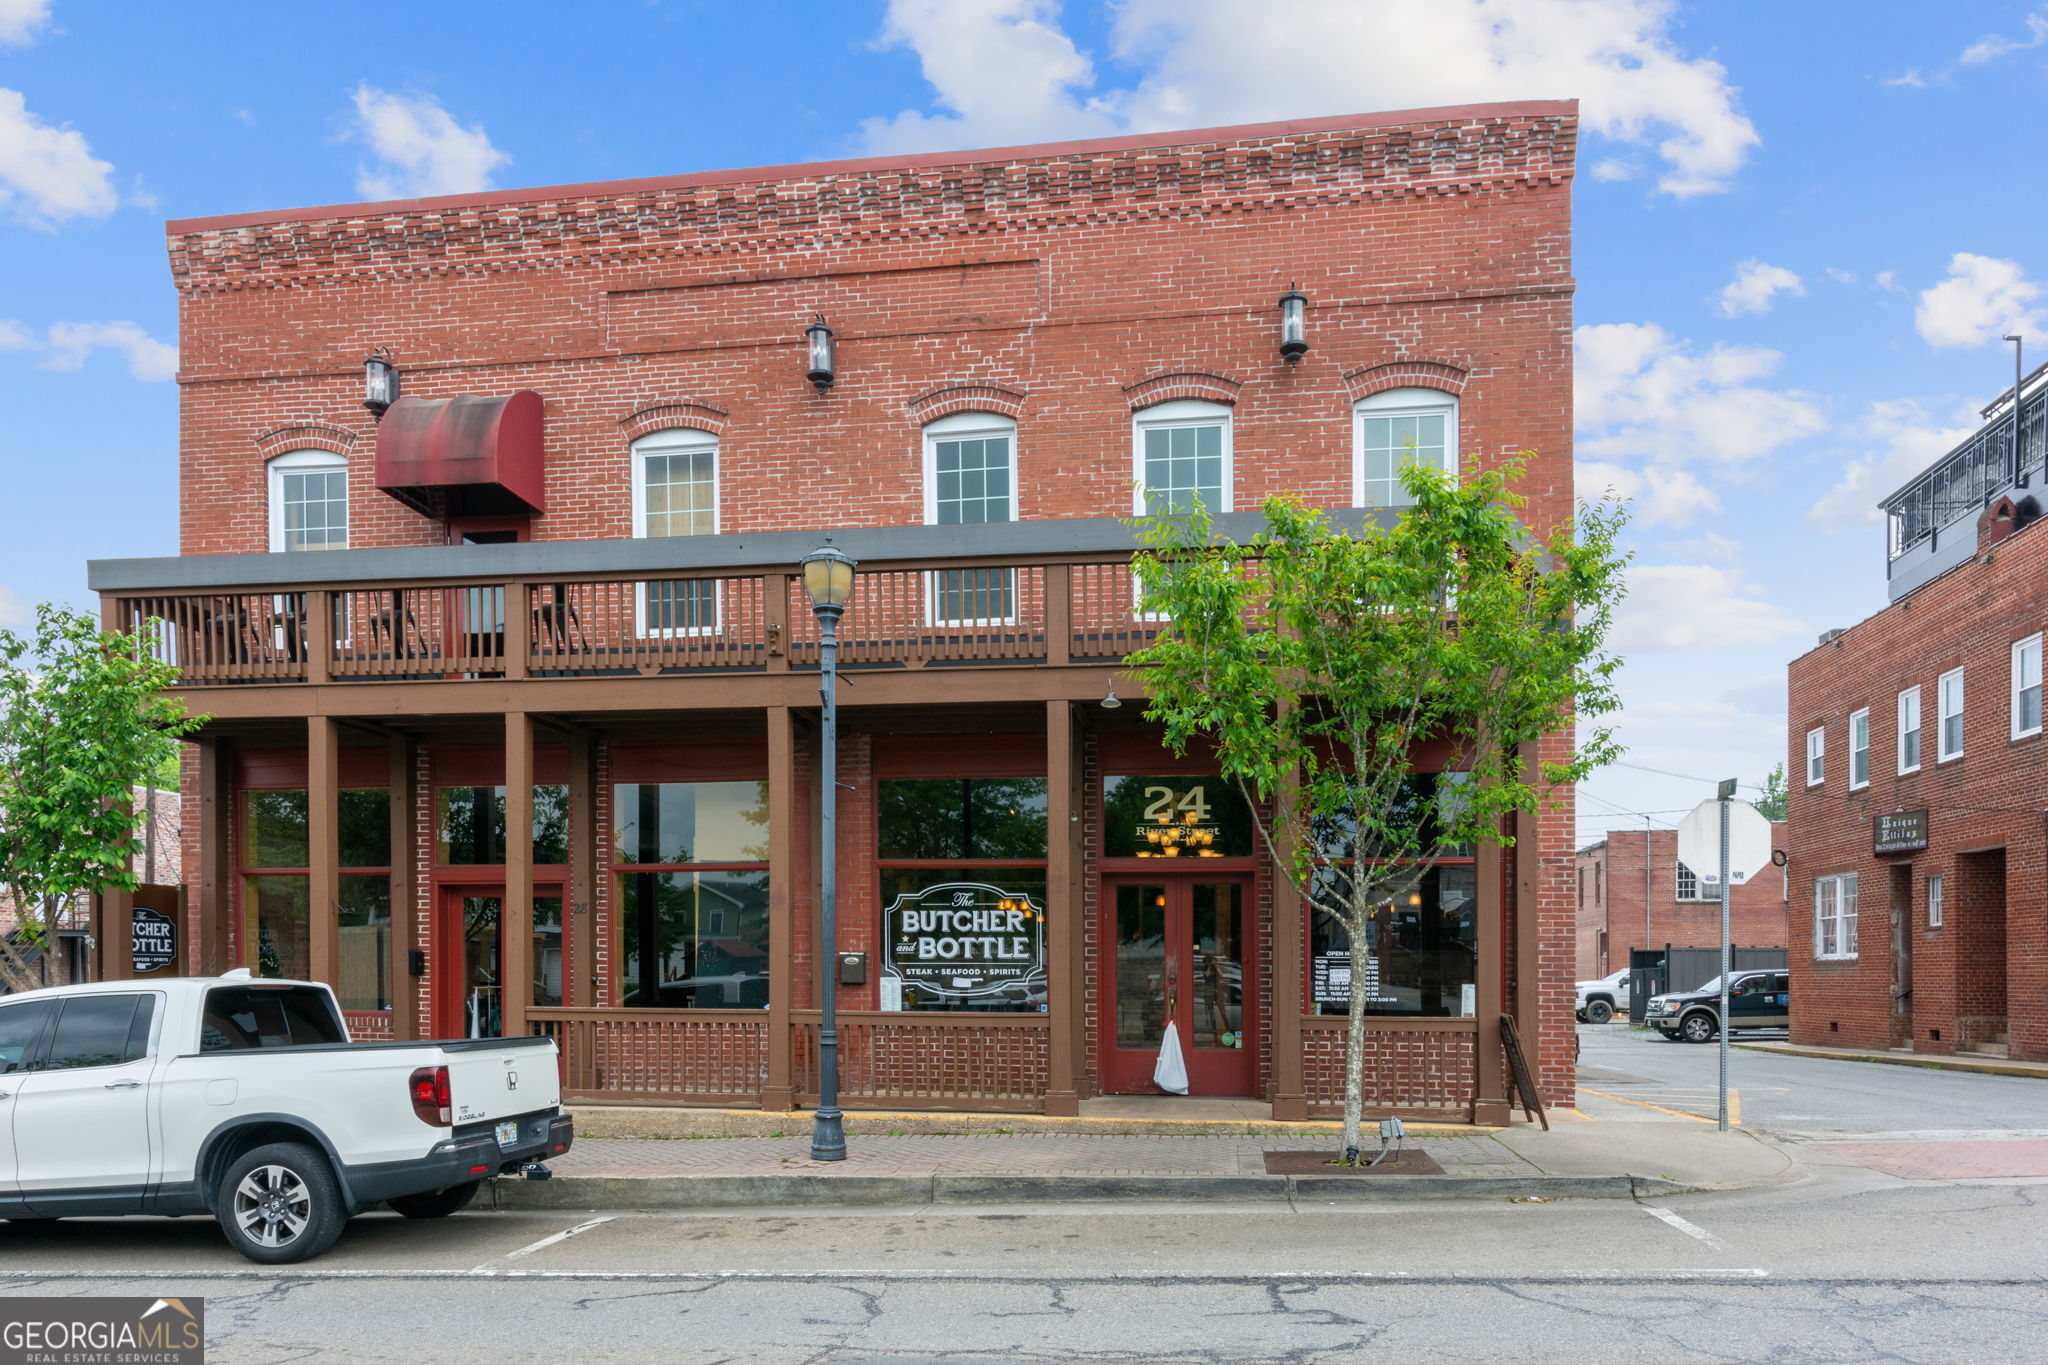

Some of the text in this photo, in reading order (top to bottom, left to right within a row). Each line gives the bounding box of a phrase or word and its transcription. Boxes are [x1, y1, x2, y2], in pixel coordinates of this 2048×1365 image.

[1144, 786, 1212, 820] 24
[1135, 826, 1220, 836] Rive Steet
[951, 892, 975, 907] The
[902, 910, 1026, 933] BUTCHER
[132, 922, 170, 937] TCHER
[132, 938, 172, 953] OTTLE
[896, 937, 1030, 960] and BOTTLE
[906, 968, 1021, 976] STEAK SEAFOOD SPIRITS
